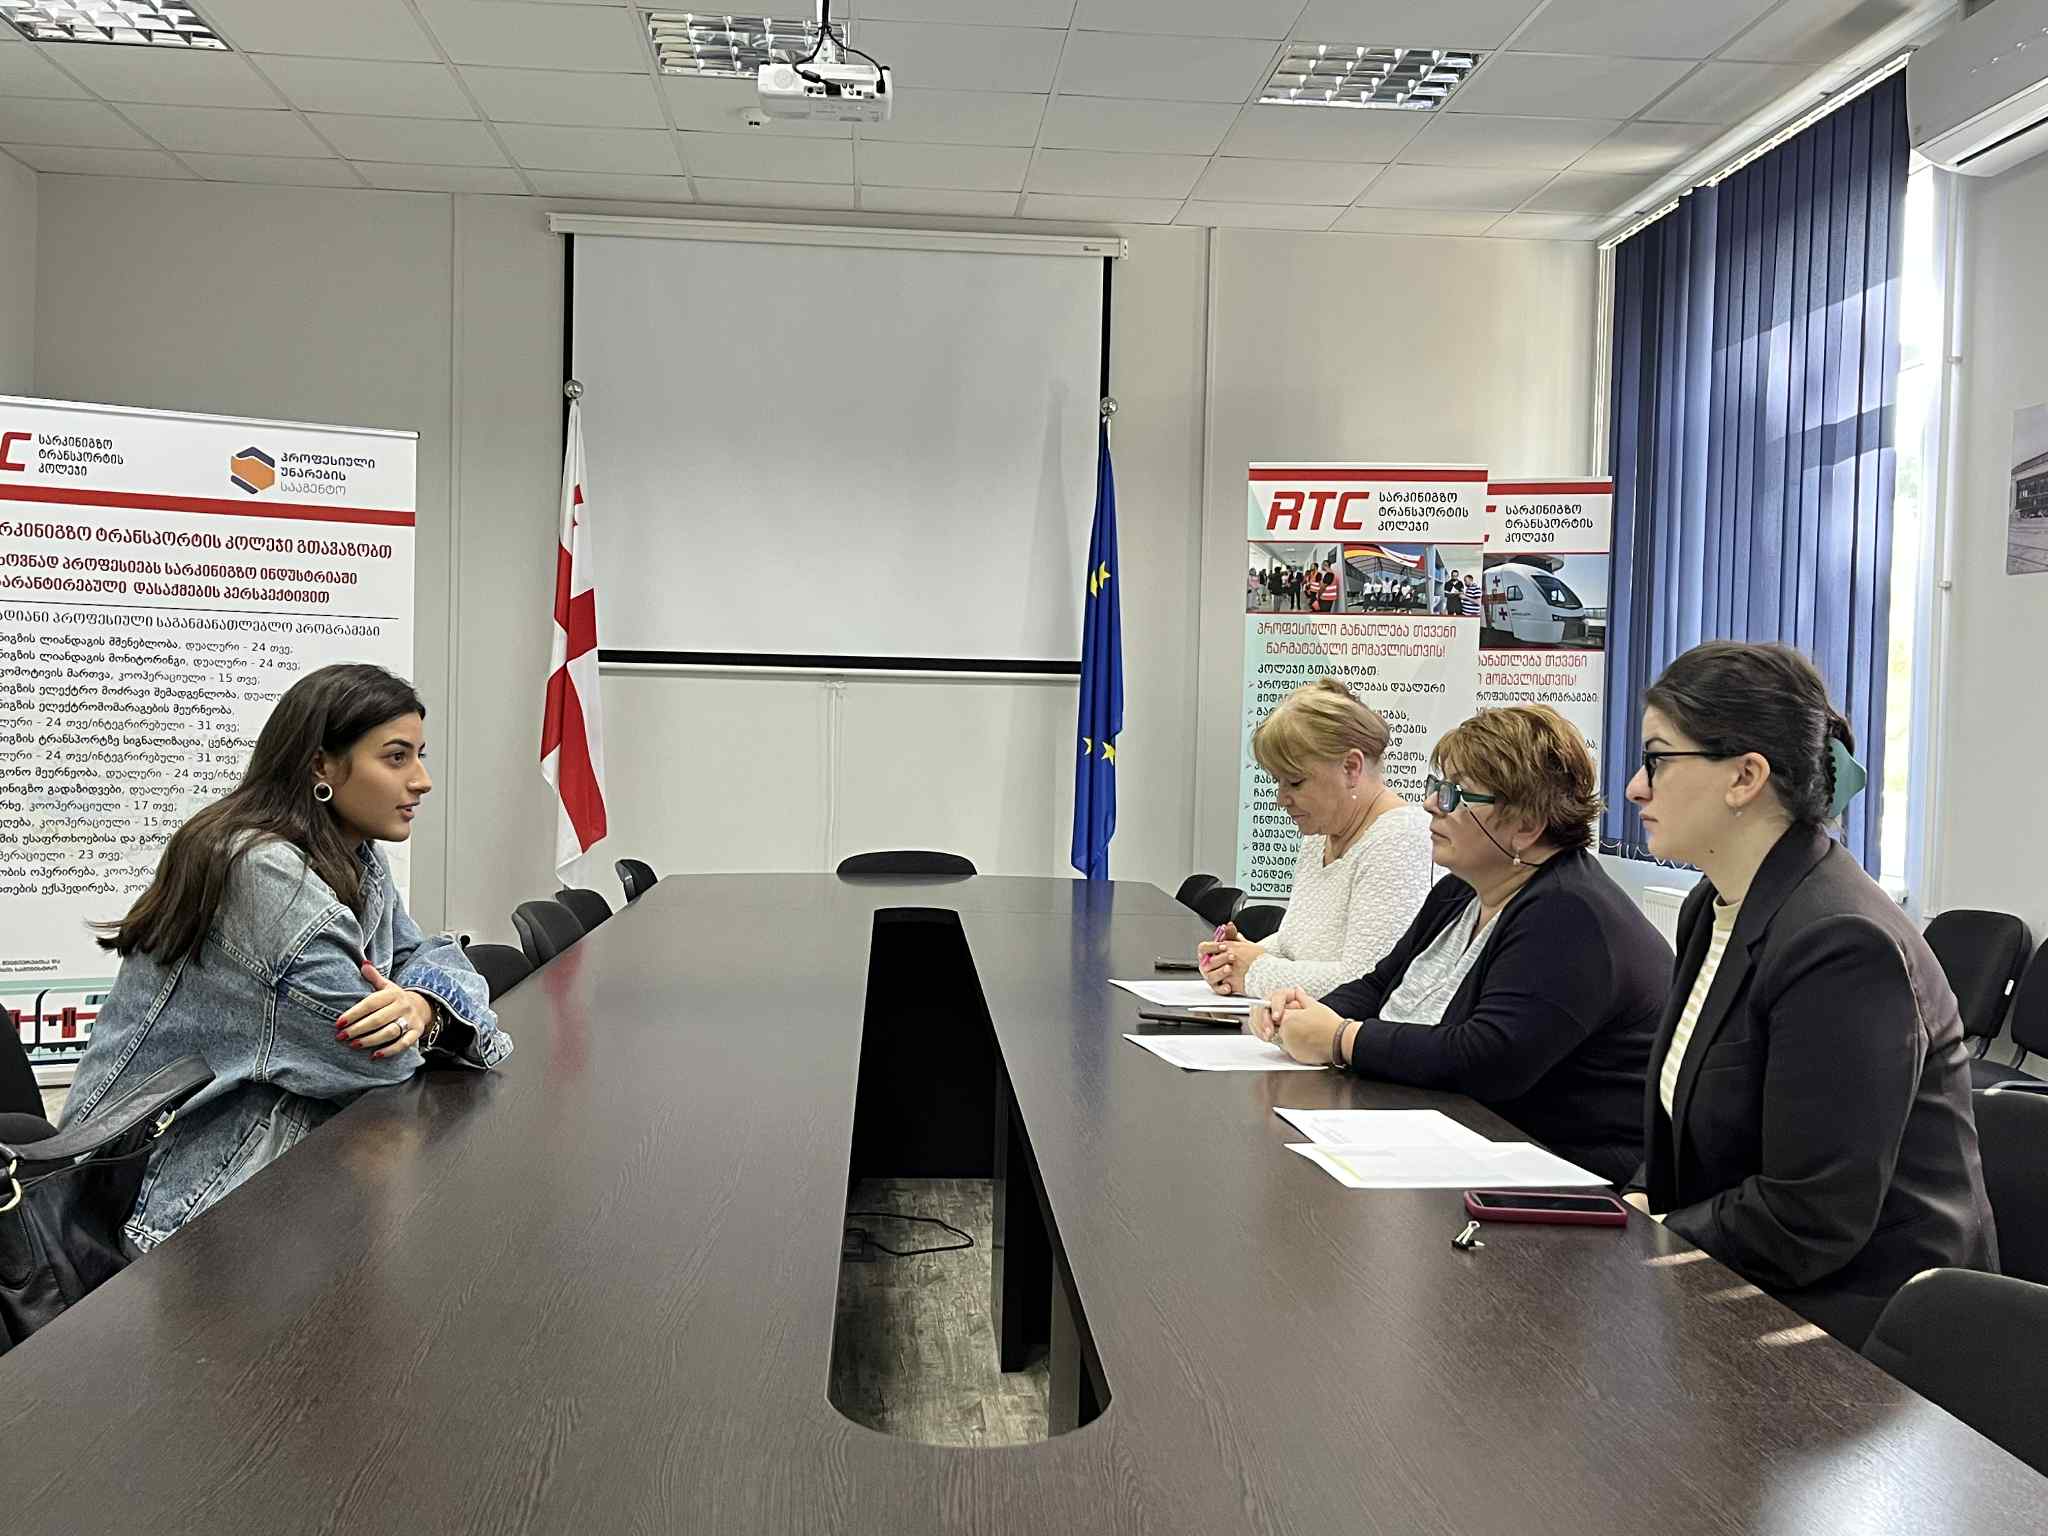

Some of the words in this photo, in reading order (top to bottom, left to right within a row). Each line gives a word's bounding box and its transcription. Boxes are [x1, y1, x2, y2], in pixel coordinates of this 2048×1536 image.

[38, 434, 112, 450] სარკინიგზო
[39, 448, 124, 464] ტრანსპორტის
[281, 453, 375, 468] პროფესიული
[39, 463, 87, 476] კოლეჯი
[281, 467, 346, 481] უნარების
[281, 481, 346, 496] სააგენტო
[1379, 491, 1457, 504] სარკინიგზო
[1266, 491, 1369, 530] RTC
[1378, 506, 1469, 519] ტრანსპორტის
[1505, 505, 1582, 515] სარკინიგზო
[1378, 519, 1429, 533] კოლეჯი
[1505, 518, 1593, 529] ტრანსპორტის
[96, 528, 221, 549] ტრანსპორტის
[226, 536, 293, 553] კოლეჯი
[297, 540, 392, 559] გთავაზობთ
[1505, 532, 1554, 543] კოლეჯი
[62, 556, 161, 574] პროფესიებს
[165, 562, 257, 579] სარკინიგზო
[261, 567, 357, 584] ინდუსტრიაში
[0, 575, 127, 594] არანტირებული
[134, 581, 219, 597] დასაქმების
[223, 587, 329, 604] პერსპექტივით
[53, 612, 153, 627] პროფესიული
[156, 617, 292, 633] საგანმანათლებლო
[296, 623, 380, 637] პროგრამები
[1257, 622, 1337, 636] პროფესიული
[1340, 624, 1409, 638] განათლება
[40, 635, 105, 647] ლიანდაგის
[185, 641, 239, 652] დუალური
[252, 643, 265, 652] 24
[40, 651, 105, 664] ლიანდაგის
[193, 658, 247, 669] დუალური
[259, 659, 273, 668] 24
[1477, 654, 1542, 667] ანათლება
[1257, 664, 1305, 674] კოლეჯი
[219, 673, 232, 683] 15
[39, 684, 97, 697] ელექტრო
[1391, 682, 1446, 693] დუალური
[46, 717, 61, 727] 24
[197, 720, 211, 730] 31
[46, 751, 61, 760] 24
[197, 753, 211, 762] 31
[105, 768, 162, 780] დუალური
[174, 769, 189, 778] 24
[129, 785, 185, 797] დუალური
[134, 801, 149, 810] 17
[144, 817, 158, 827] 15
[120, 835, 136, 845] და
[1272, 843, 1288, 853] და
[78, 850, 94, 860] 23
